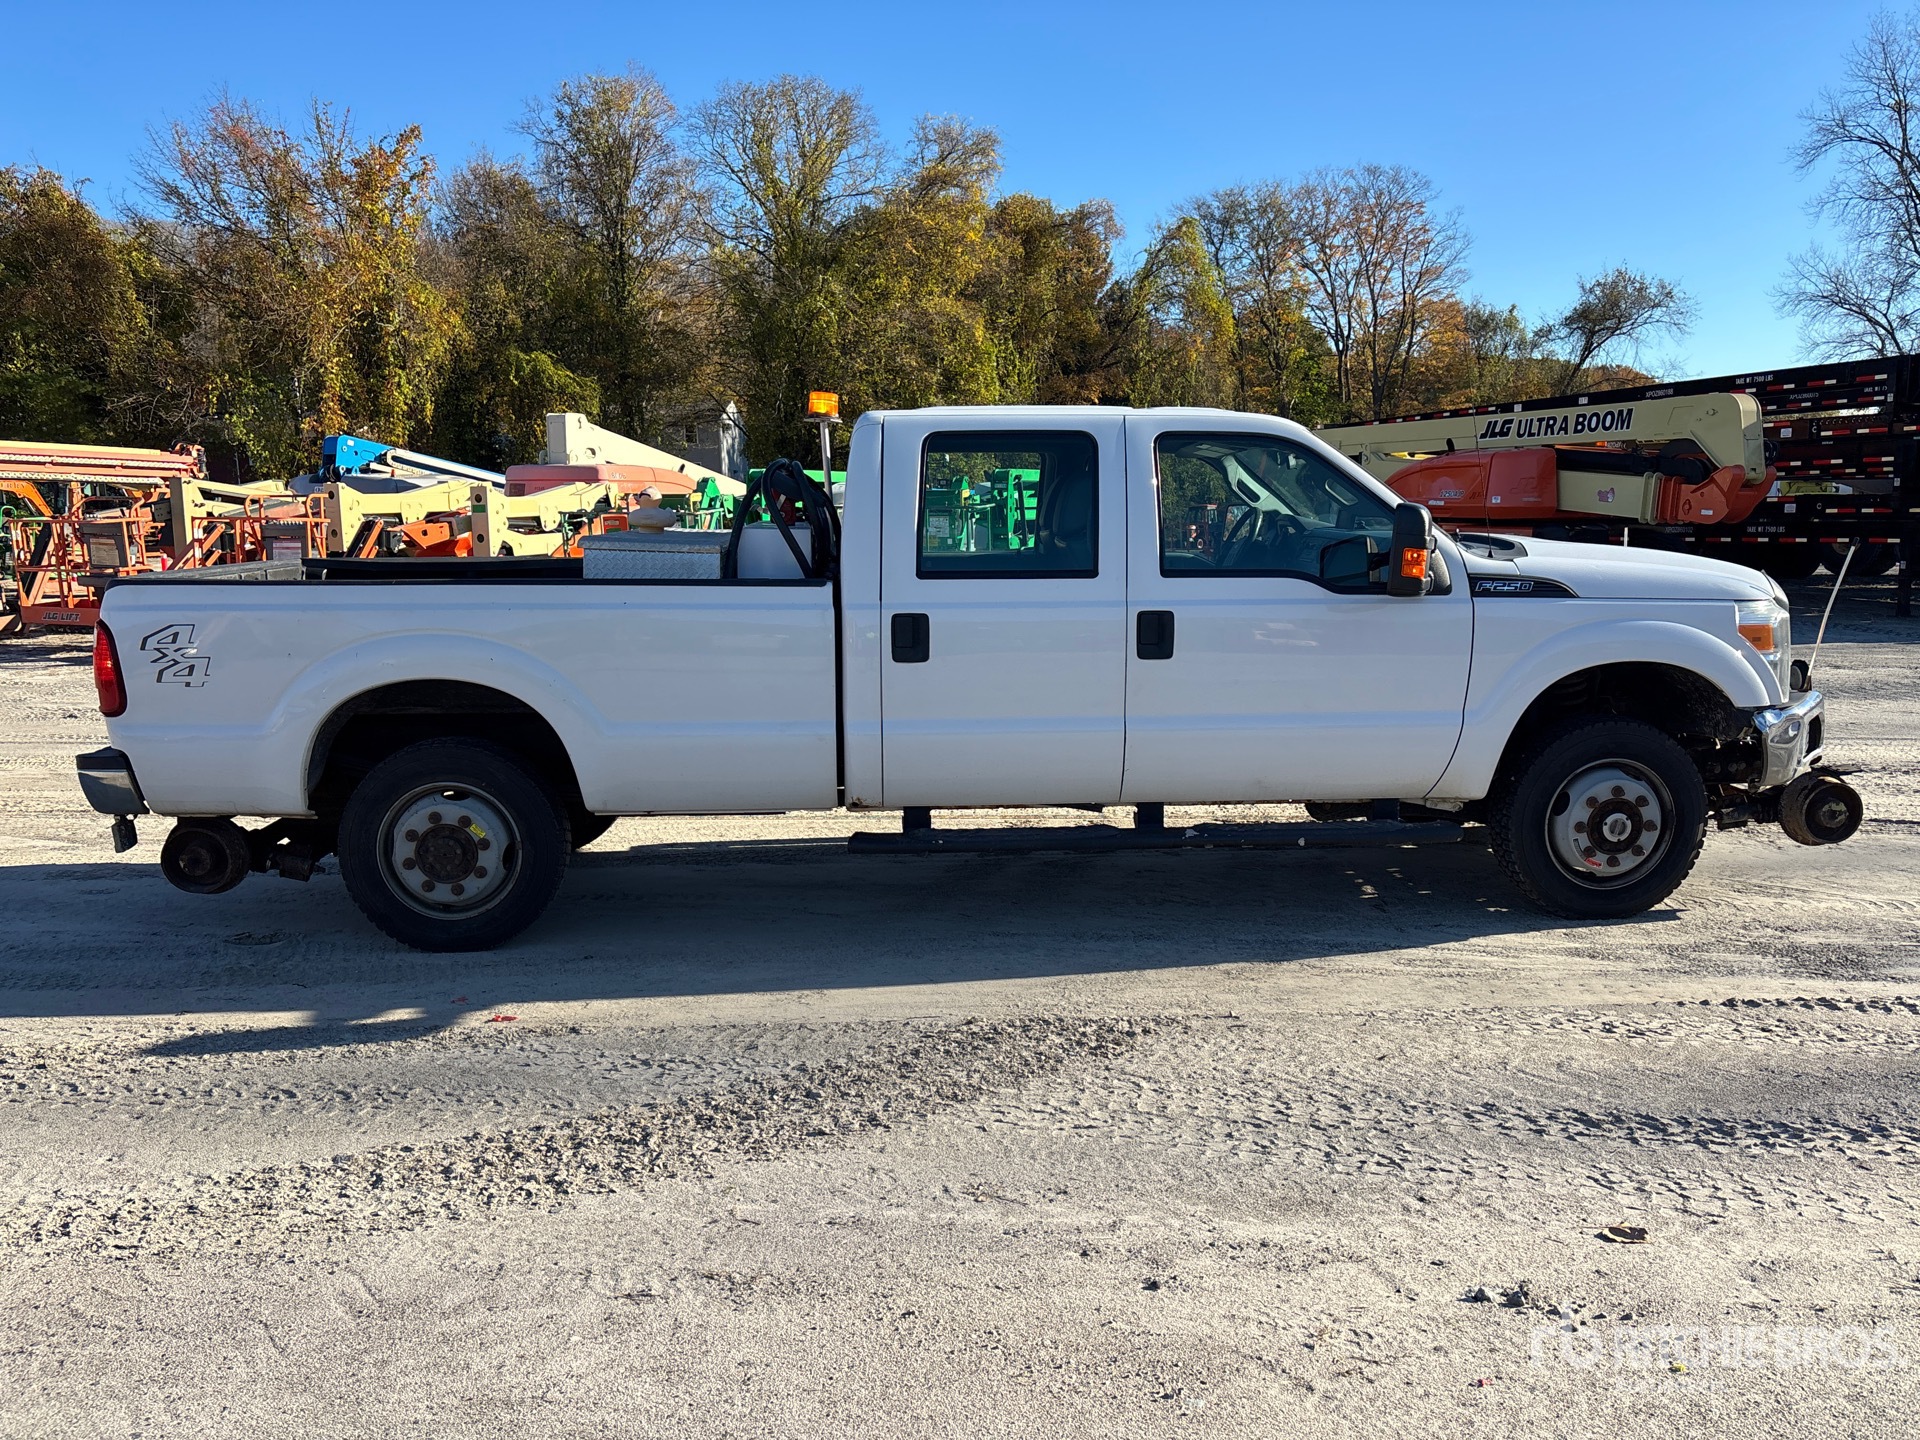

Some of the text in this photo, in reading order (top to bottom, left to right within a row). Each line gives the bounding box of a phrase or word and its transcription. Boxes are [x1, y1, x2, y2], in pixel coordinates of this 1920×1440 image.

[1479, 407, 1635, 441] JLG ULTRA BOOM
[42, 612, 80, 621] JLG LIFT
